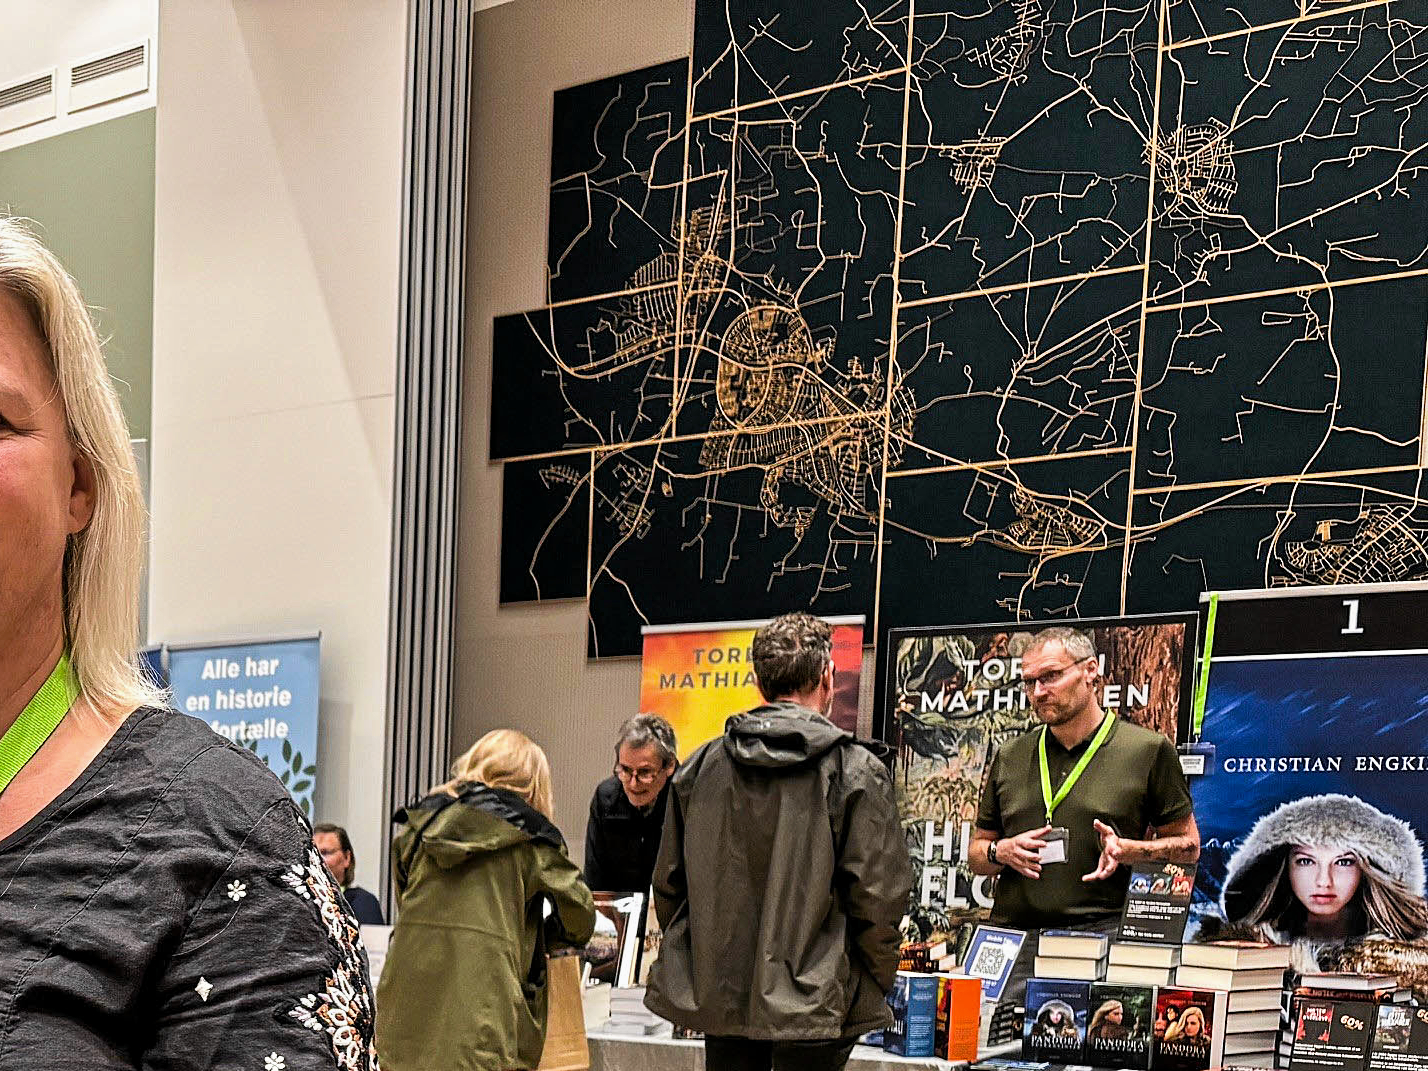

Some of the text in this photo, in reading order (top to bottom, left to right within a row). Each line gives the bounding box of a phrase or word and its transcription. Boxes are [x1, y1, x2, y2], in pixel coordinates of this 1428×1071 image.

[1341, 600, 1364, 634] 1
[202, 656, 279, 680] Alle har
[186, 686, 292, 711] en historie
[1223, 756, 1342, 773] CHRISTIAN
[1031, 1034, 1082, 1046] PANDORA
[1094, 1037, 1145, 1049] PANDORA
[1160, 1042, 1206, 1054] PANDORA
